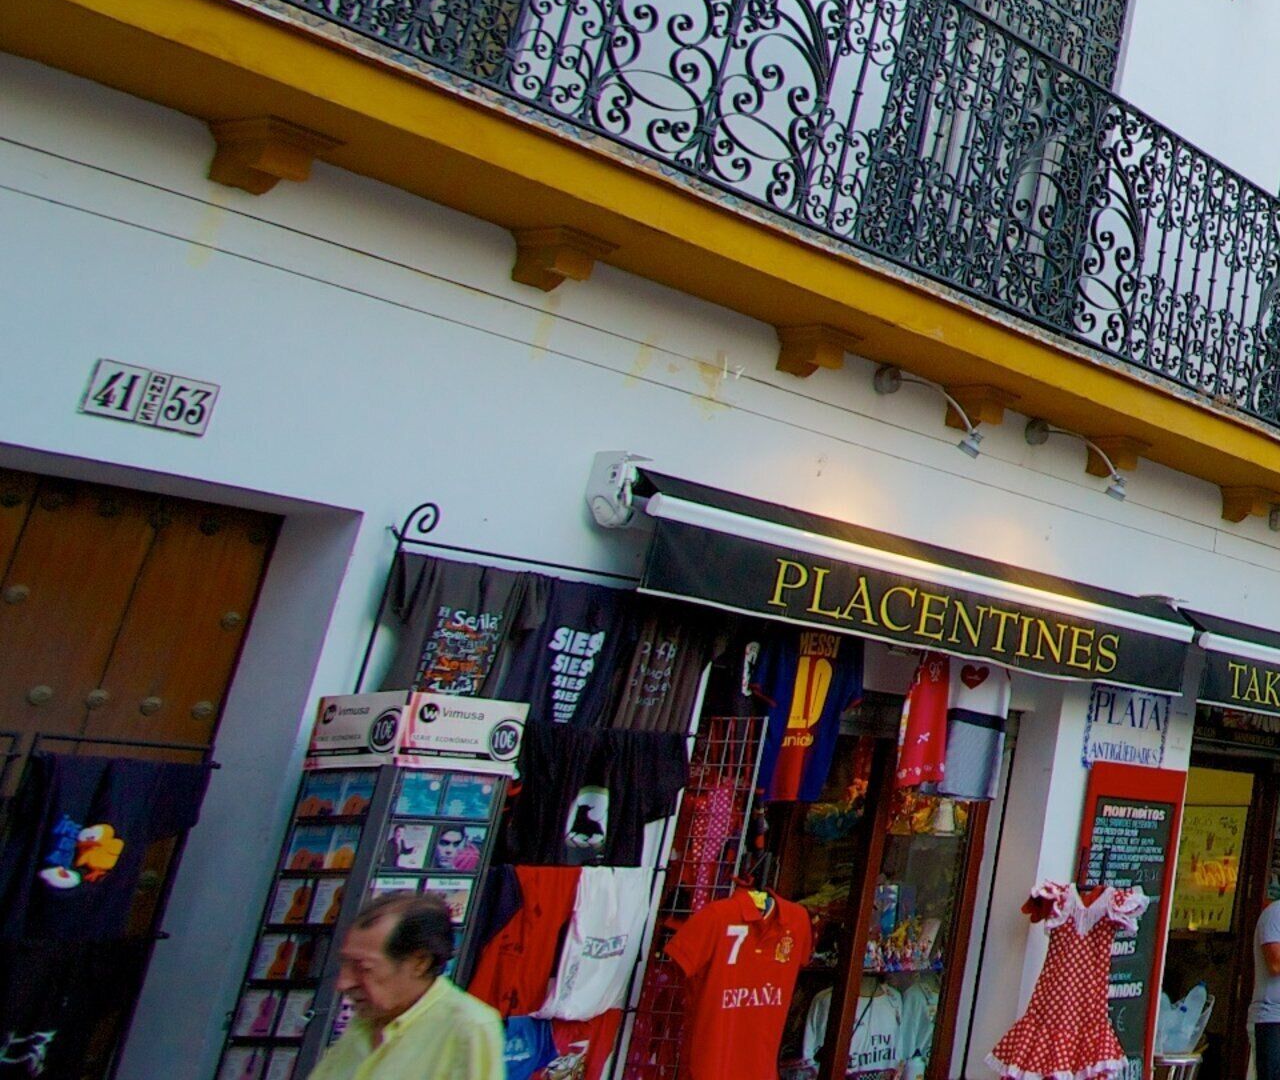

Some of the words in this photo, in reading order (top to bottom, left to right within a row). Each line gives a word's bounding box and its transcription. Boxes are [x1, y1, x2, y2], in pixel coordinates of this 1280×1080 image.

[92, 371, 141, 412] 41
[139, 375, 167, 421] ANTES
[164, 385, 212, 425] 53
[768, 558, 1121, 673] PLACENTINES
[374, 720, 394, 739] 10€
[442, 706, 485, 721] Vimusa
[1093, 690, 1160, 731] PLATA
[493, 731, 515, 749] 10€
[726, 925, 749, 965] 7
[722, 982, 783, 1009] ESPAÑA
[871, 1034, 891, 1046] Fly
